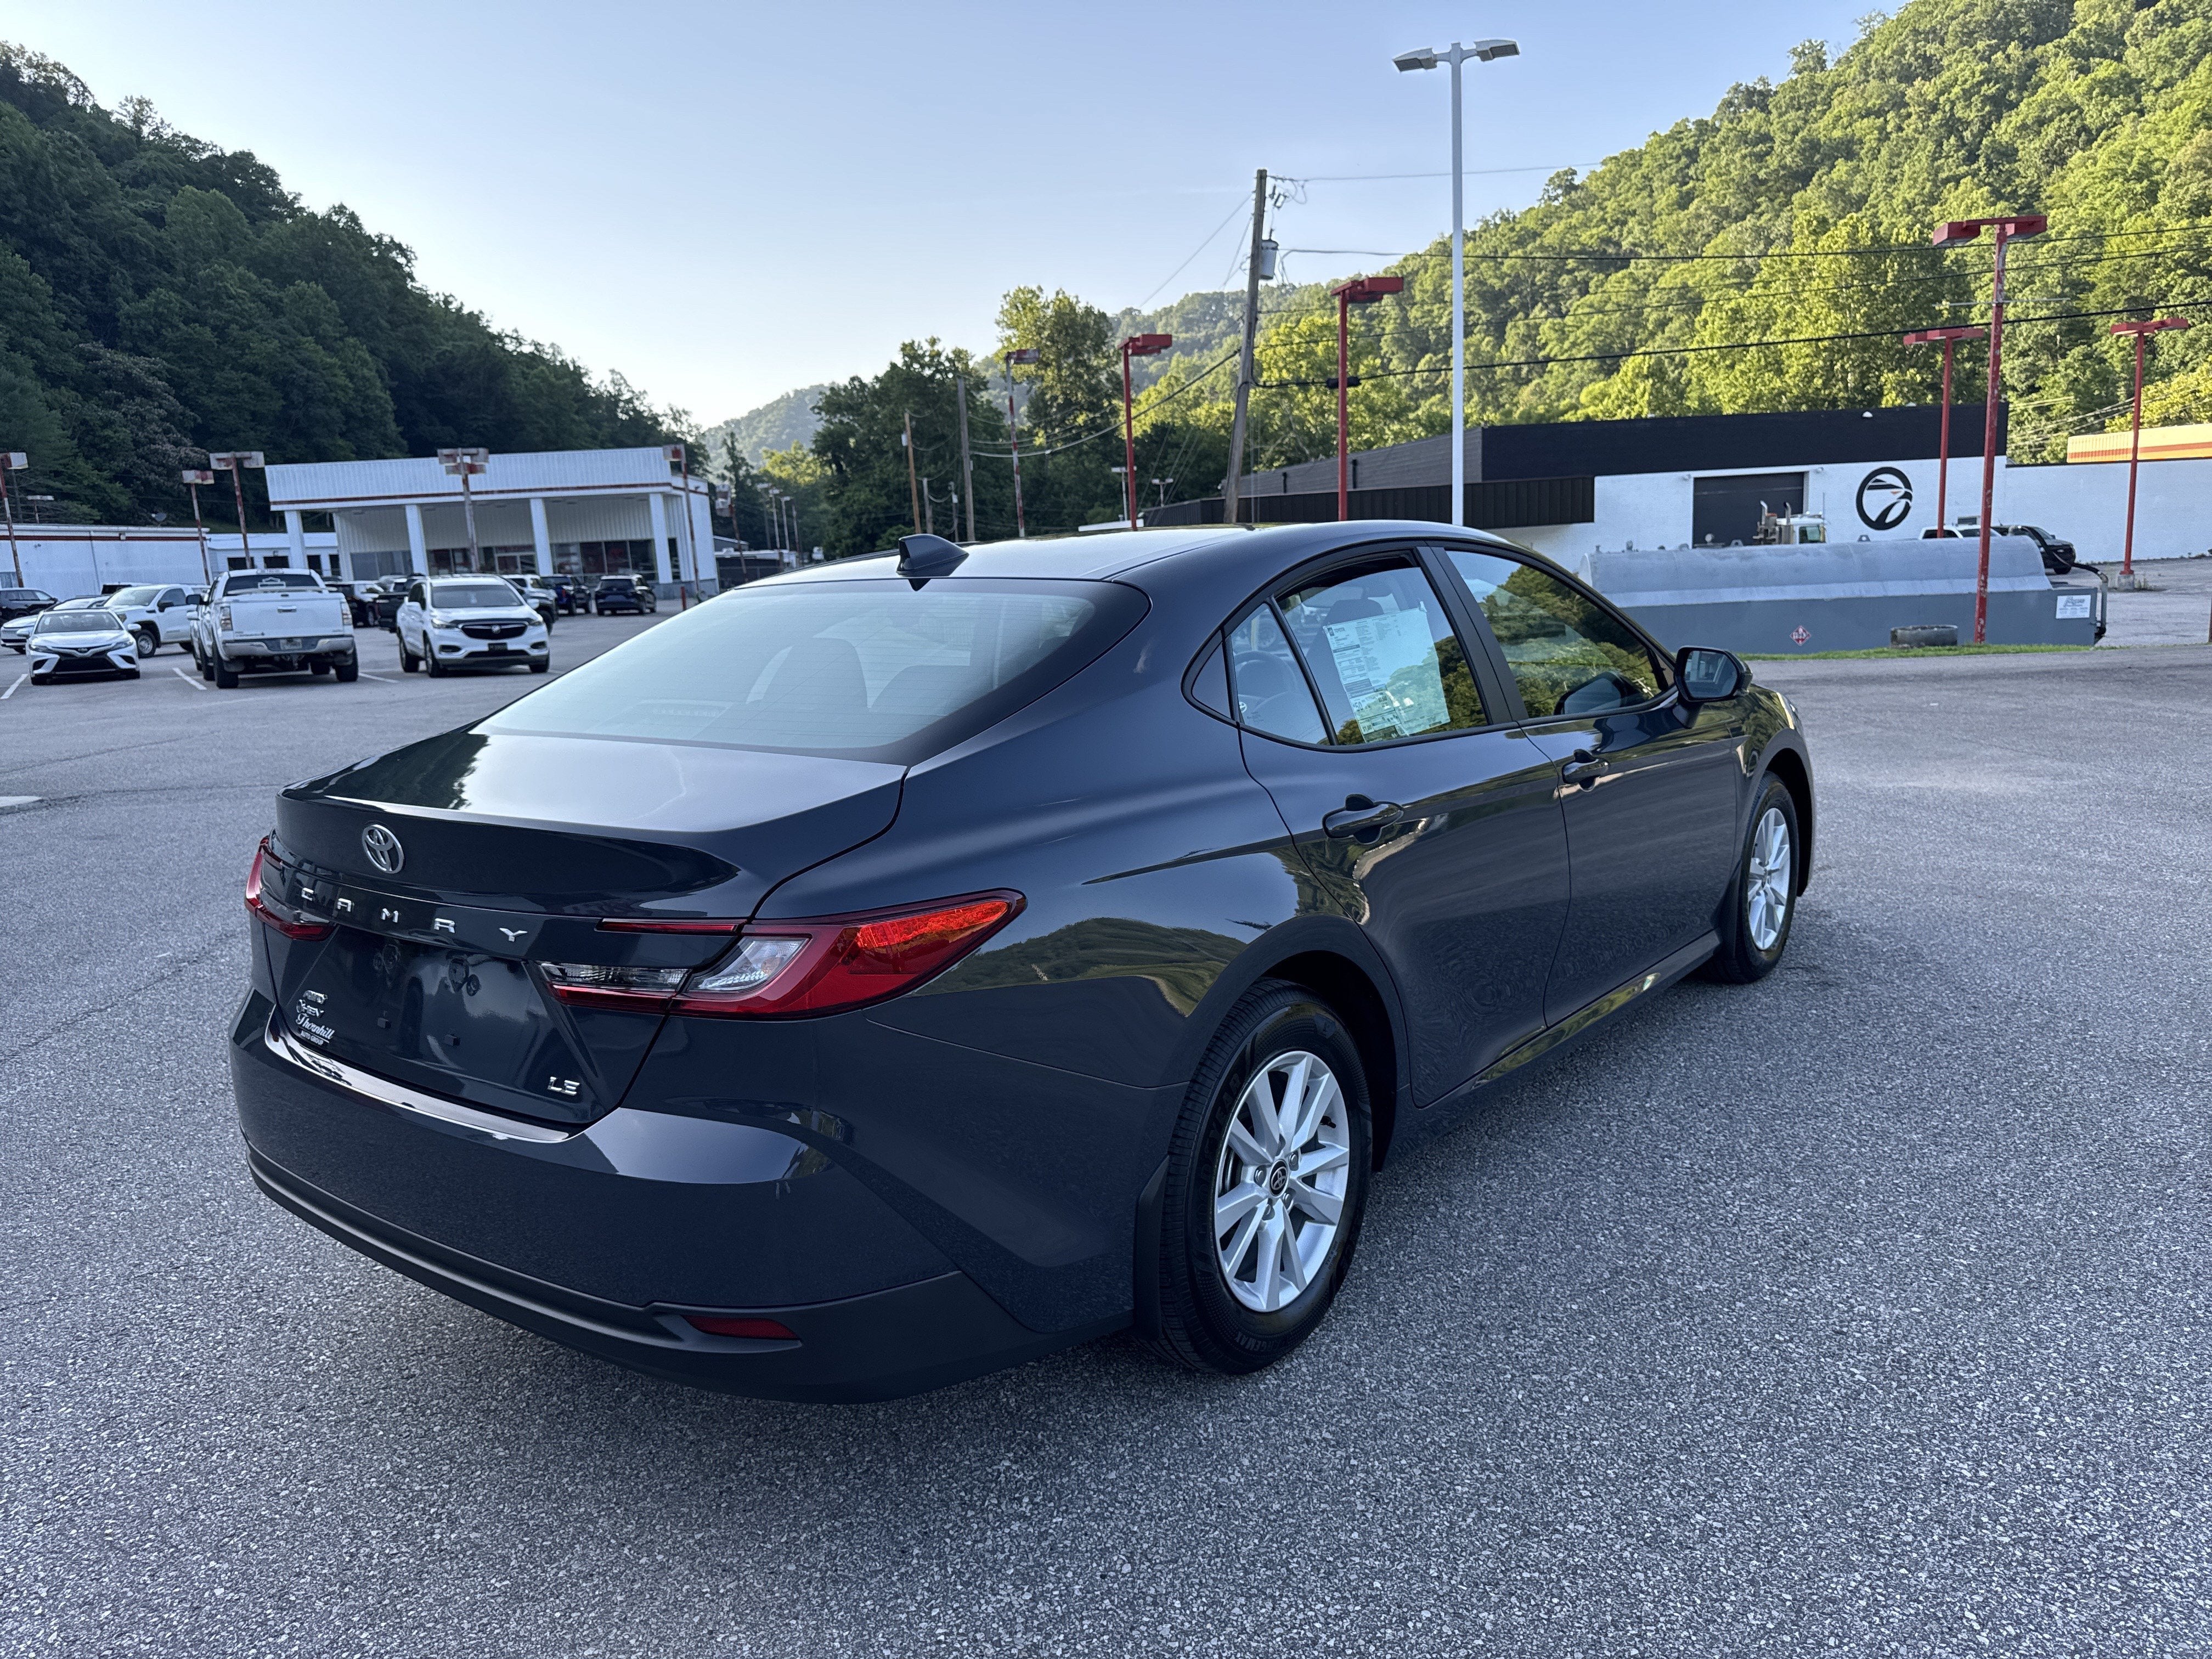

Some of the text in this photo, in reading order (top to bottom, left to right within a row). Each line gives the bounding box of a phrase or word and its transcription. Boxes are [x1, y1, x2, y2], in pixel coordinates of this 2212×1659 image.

[301, 887, 528, 943] CAMRY
[296, 1013, 335, 1040] Thornhill
[548, 1076, 580, 1096] LE
